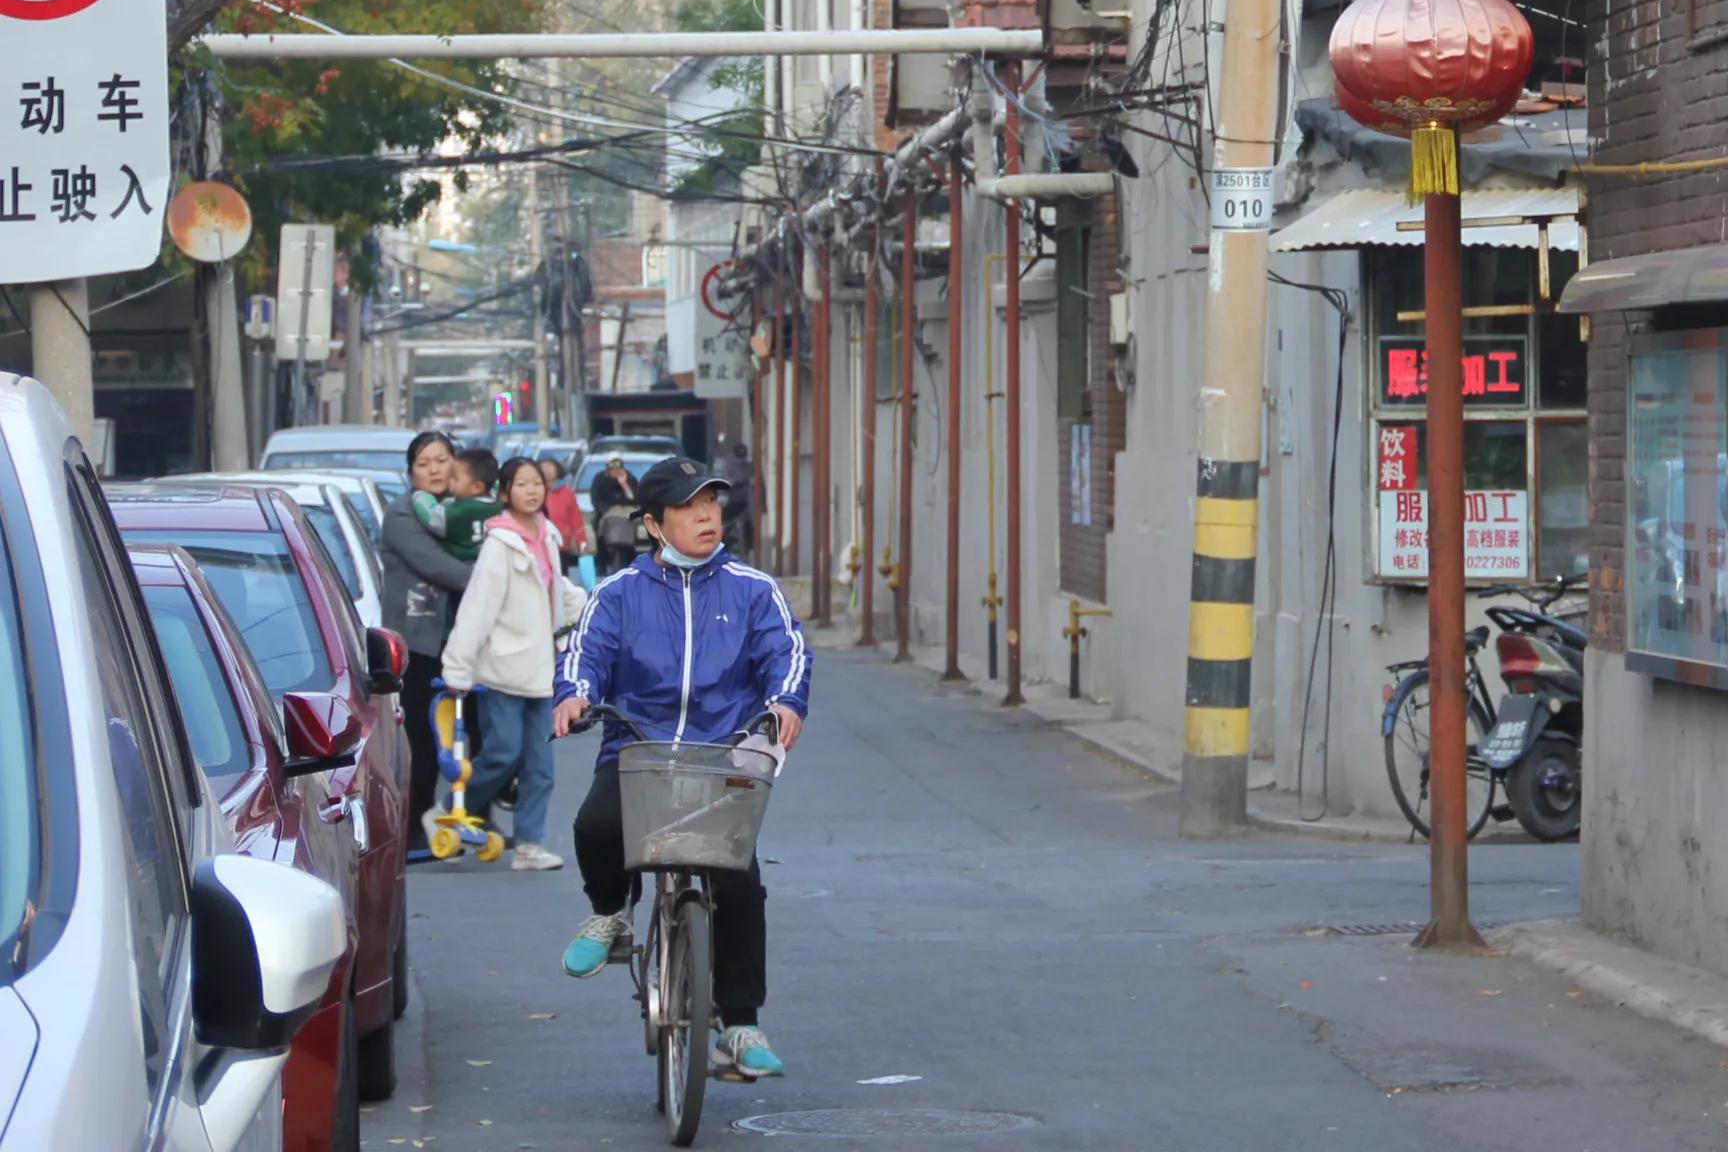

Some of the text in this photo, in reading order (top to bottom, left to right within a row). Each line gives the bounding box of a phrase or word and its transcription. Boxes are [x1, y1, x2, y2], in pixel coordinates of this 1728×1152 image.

[20, 73, 143, 135] 动车
[0, 164, 153, 223] 止驶入
[1225, 199, 1262, 218] 010
[1388, 349, 1520, 396] 服加工
[1380, 428, 1406, 488] 饮料
[1396, 492, 1519, 523] 服加工
[1395, 528, 1520, 549] 修改高档服装
[1466, 556, 1520, 569] 0227306
